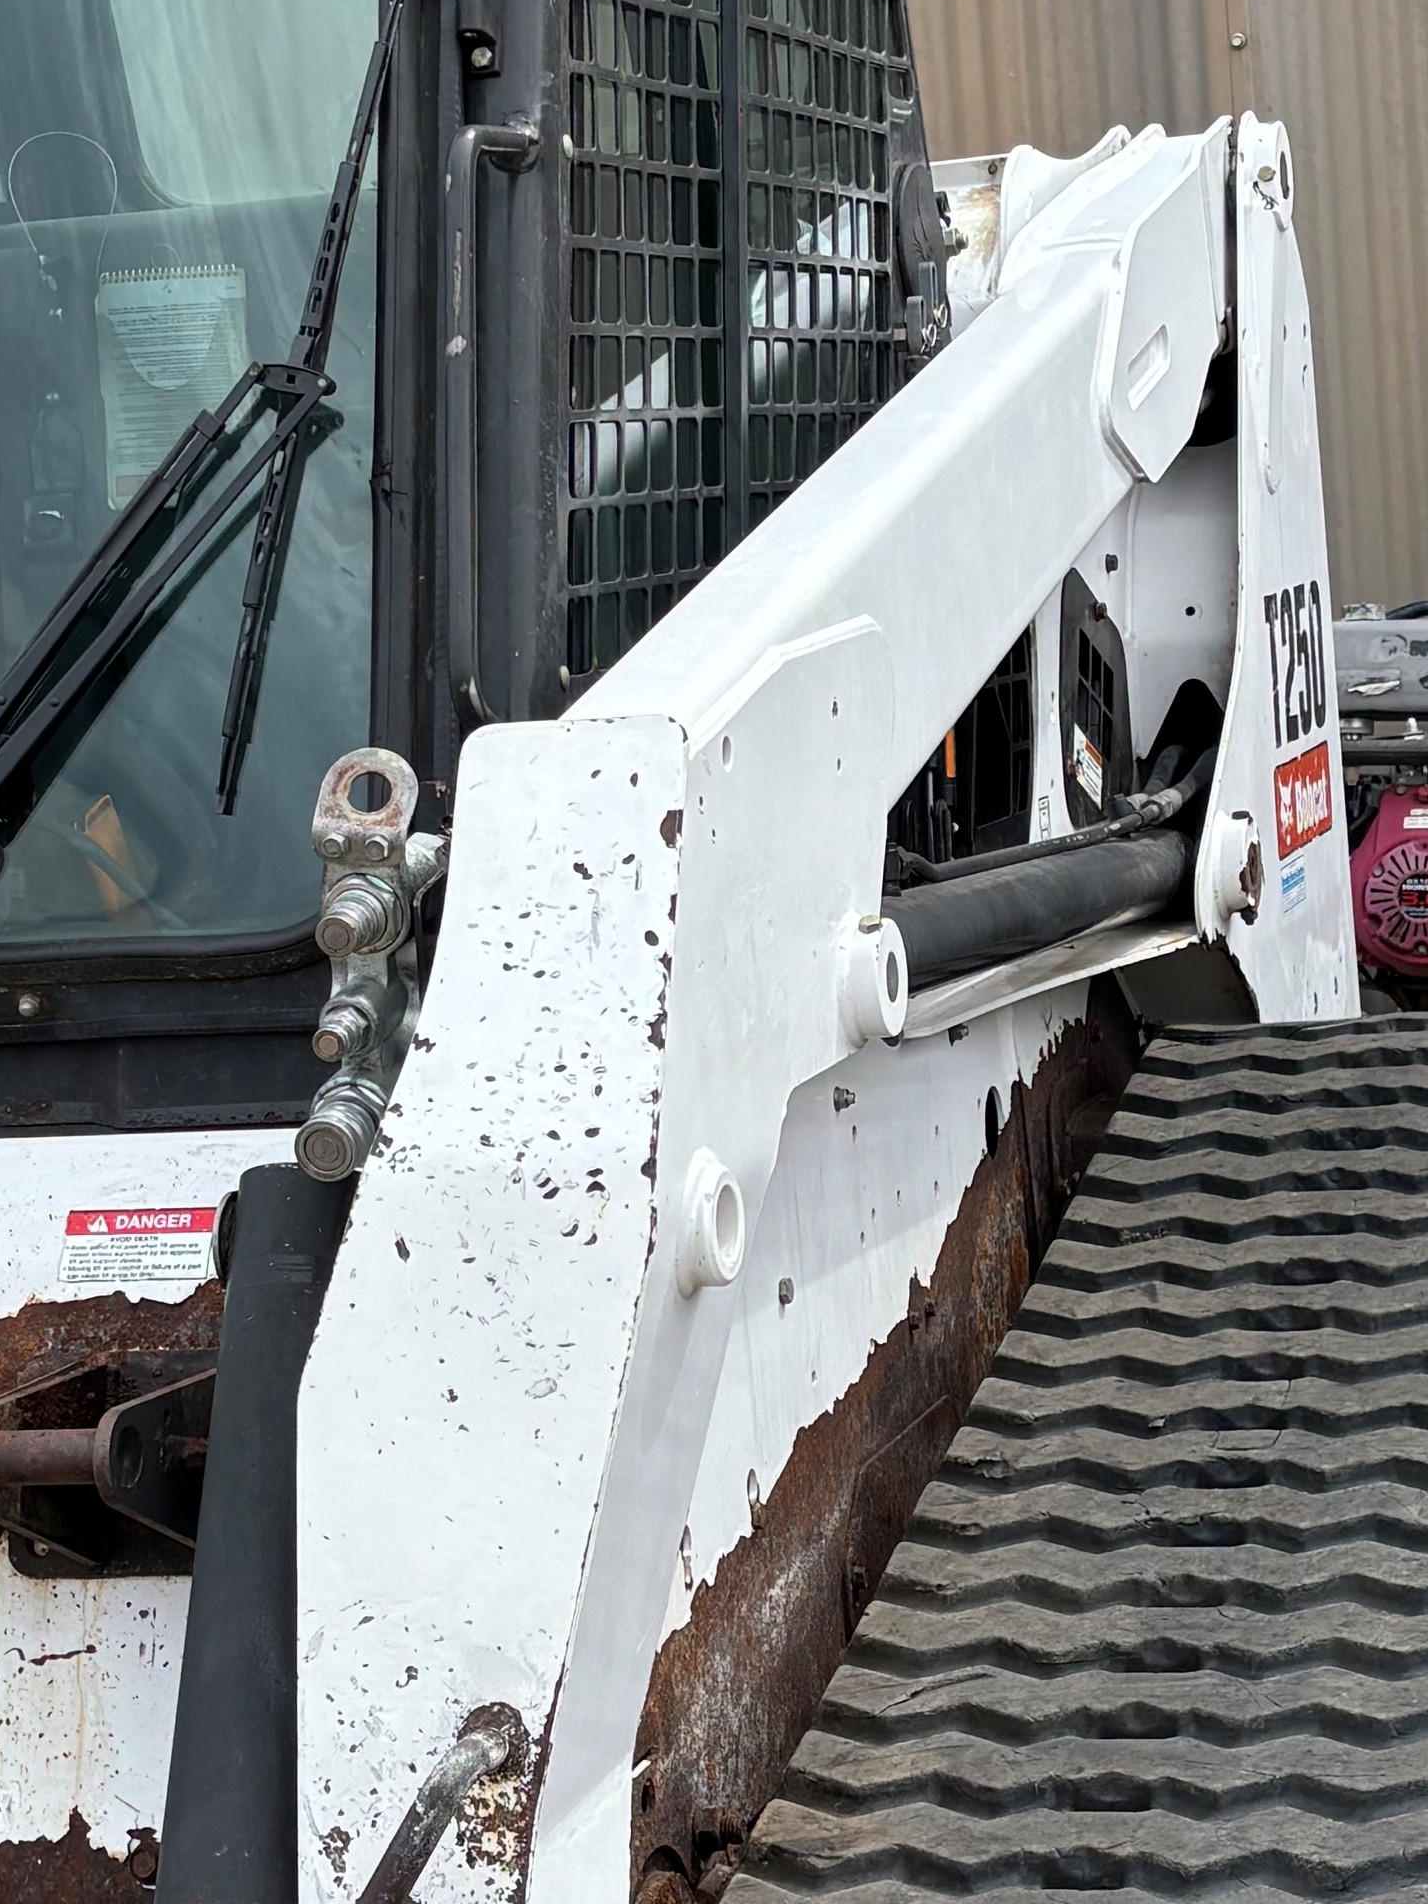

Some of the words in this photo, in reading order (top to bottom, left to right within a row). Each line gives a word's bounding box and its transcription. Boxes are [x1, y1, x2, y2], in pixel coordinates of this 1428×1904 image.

[1264, 580, 1327, 749] T250
[1295, 770, 1328, 835] Bobcat
[115, 1213, 192, 1230] DANGER
